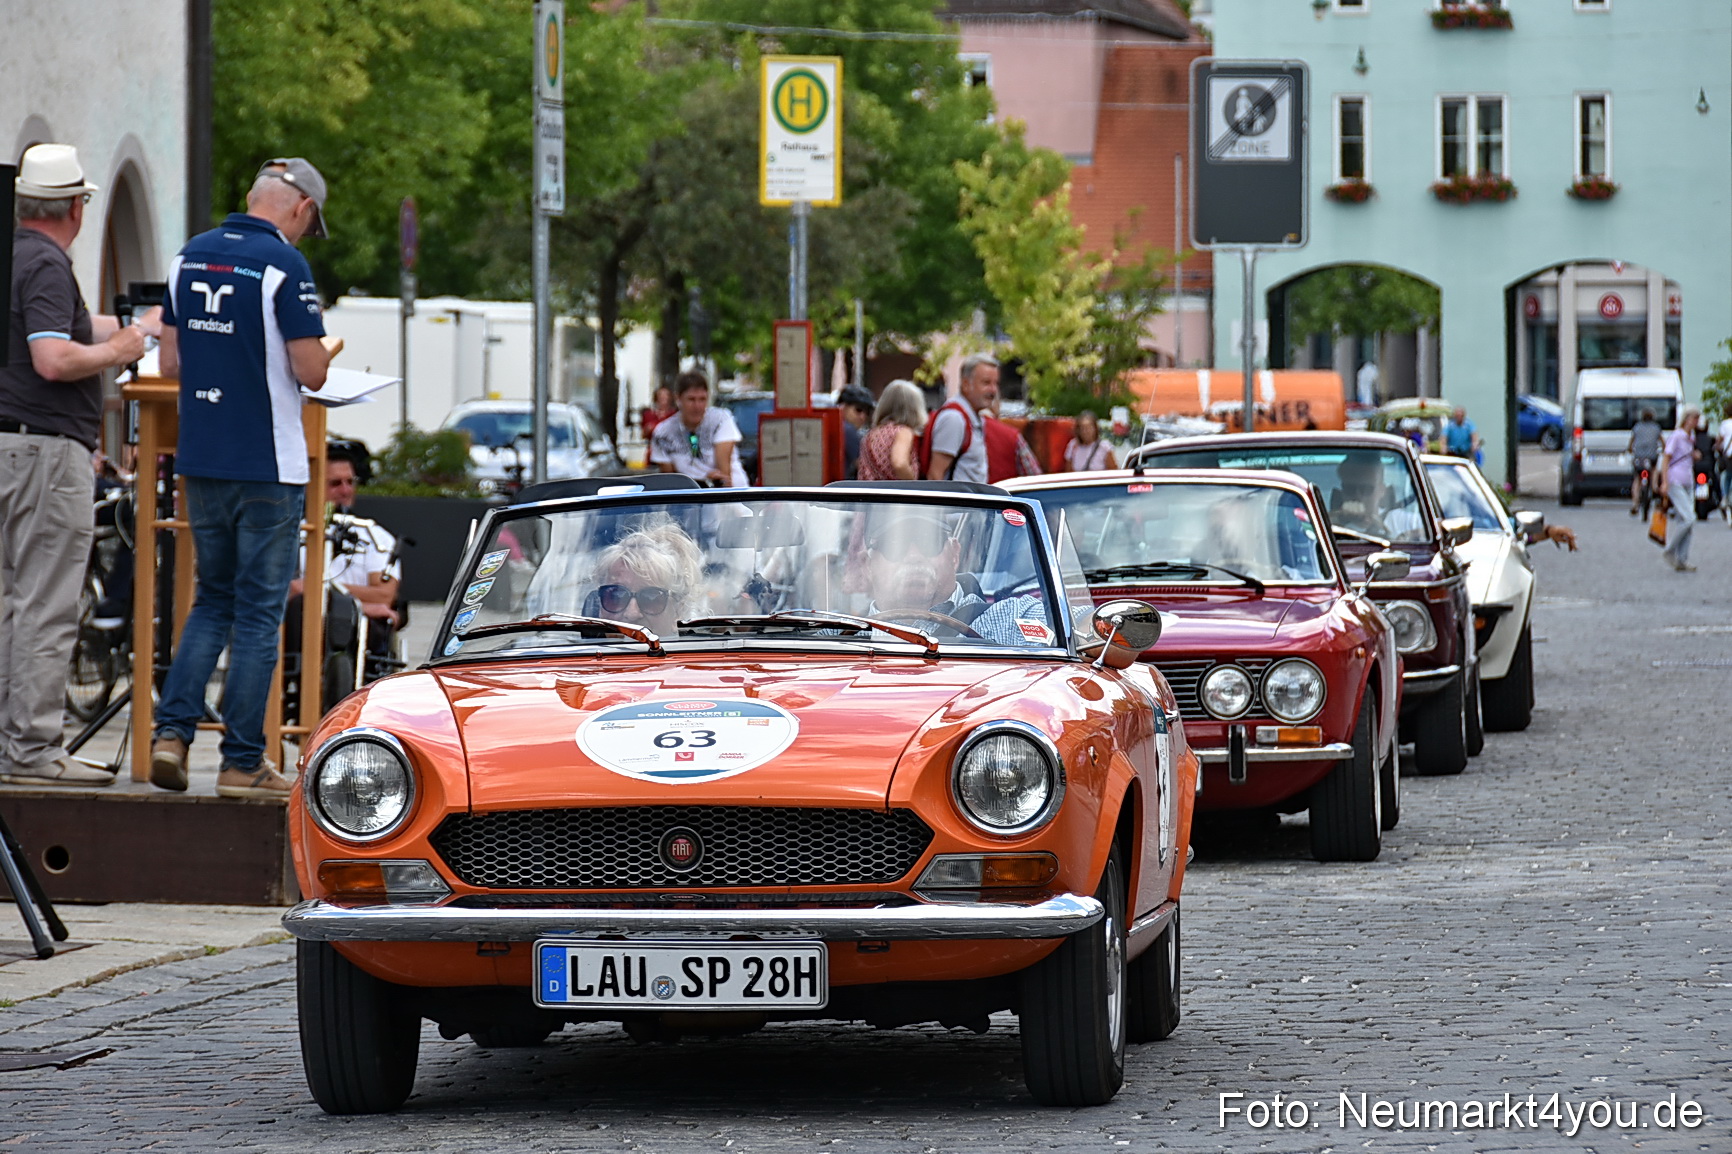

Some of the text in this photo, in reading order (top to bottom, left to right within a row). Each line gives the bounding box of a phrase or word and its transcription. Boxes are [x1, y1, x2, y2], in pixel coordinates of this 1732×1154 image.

[789, 82, 812, 119] H
[1229, 140, 1271, 156] ZONE
[187, 317, 234, 335] randstad
[652, 729, 717, 749] 63
[672, 843, 691, 856] FIAT
[570, 955, 817, 998] LAU SP 28H
[549, 980, 560, 993] D
